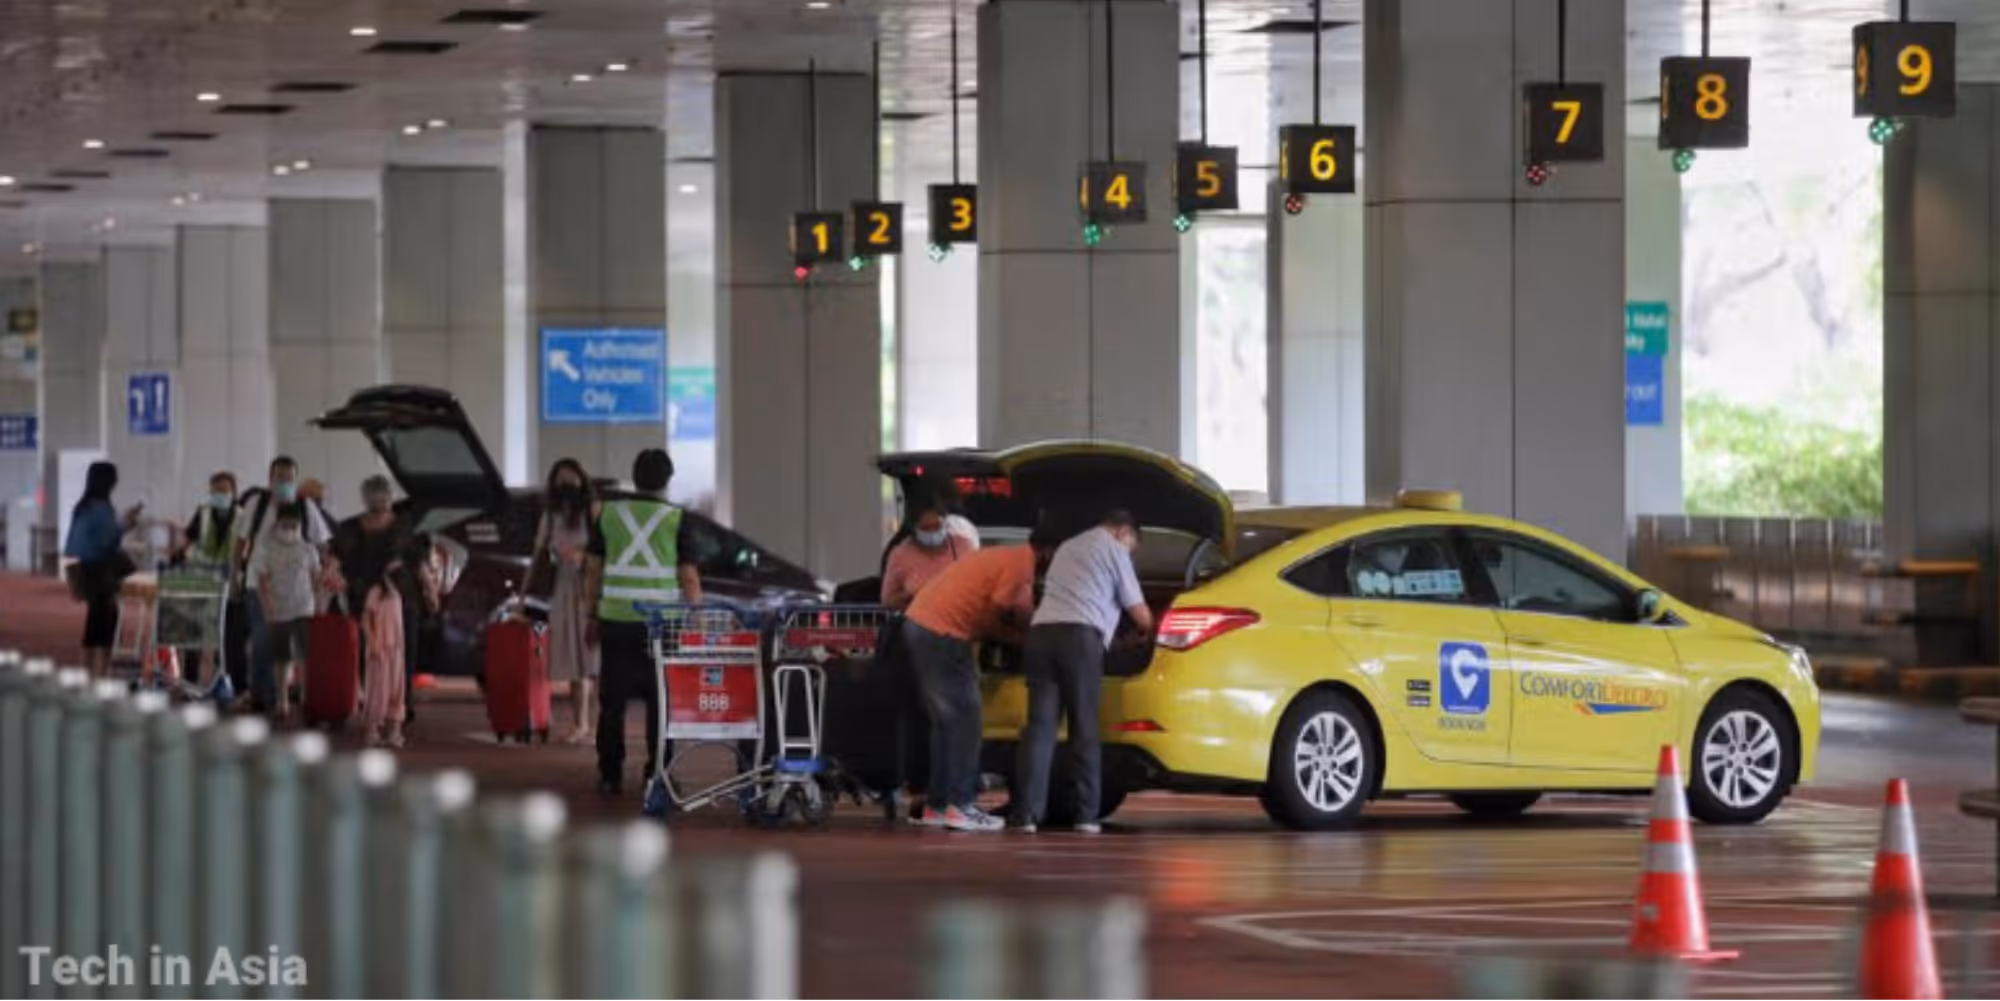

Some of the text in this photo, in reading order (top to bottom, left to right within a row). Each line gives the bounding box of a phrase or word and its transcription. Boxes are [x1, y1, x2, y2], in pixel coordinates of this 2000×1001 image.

[1897, 44, 1933, 95] 9
[1694, 73, 1728, 120] 8
[1551, 101, 1582, 144] 7
[1309, 138, 1337, 180] 6
[1104, 173, 1132, 209] 4
[1196, 160, 1221, 197] 5
[868, 211, 891, 244] 2
[951, 197, 972, 231] 3
[811, 221, 829, 254] 1
